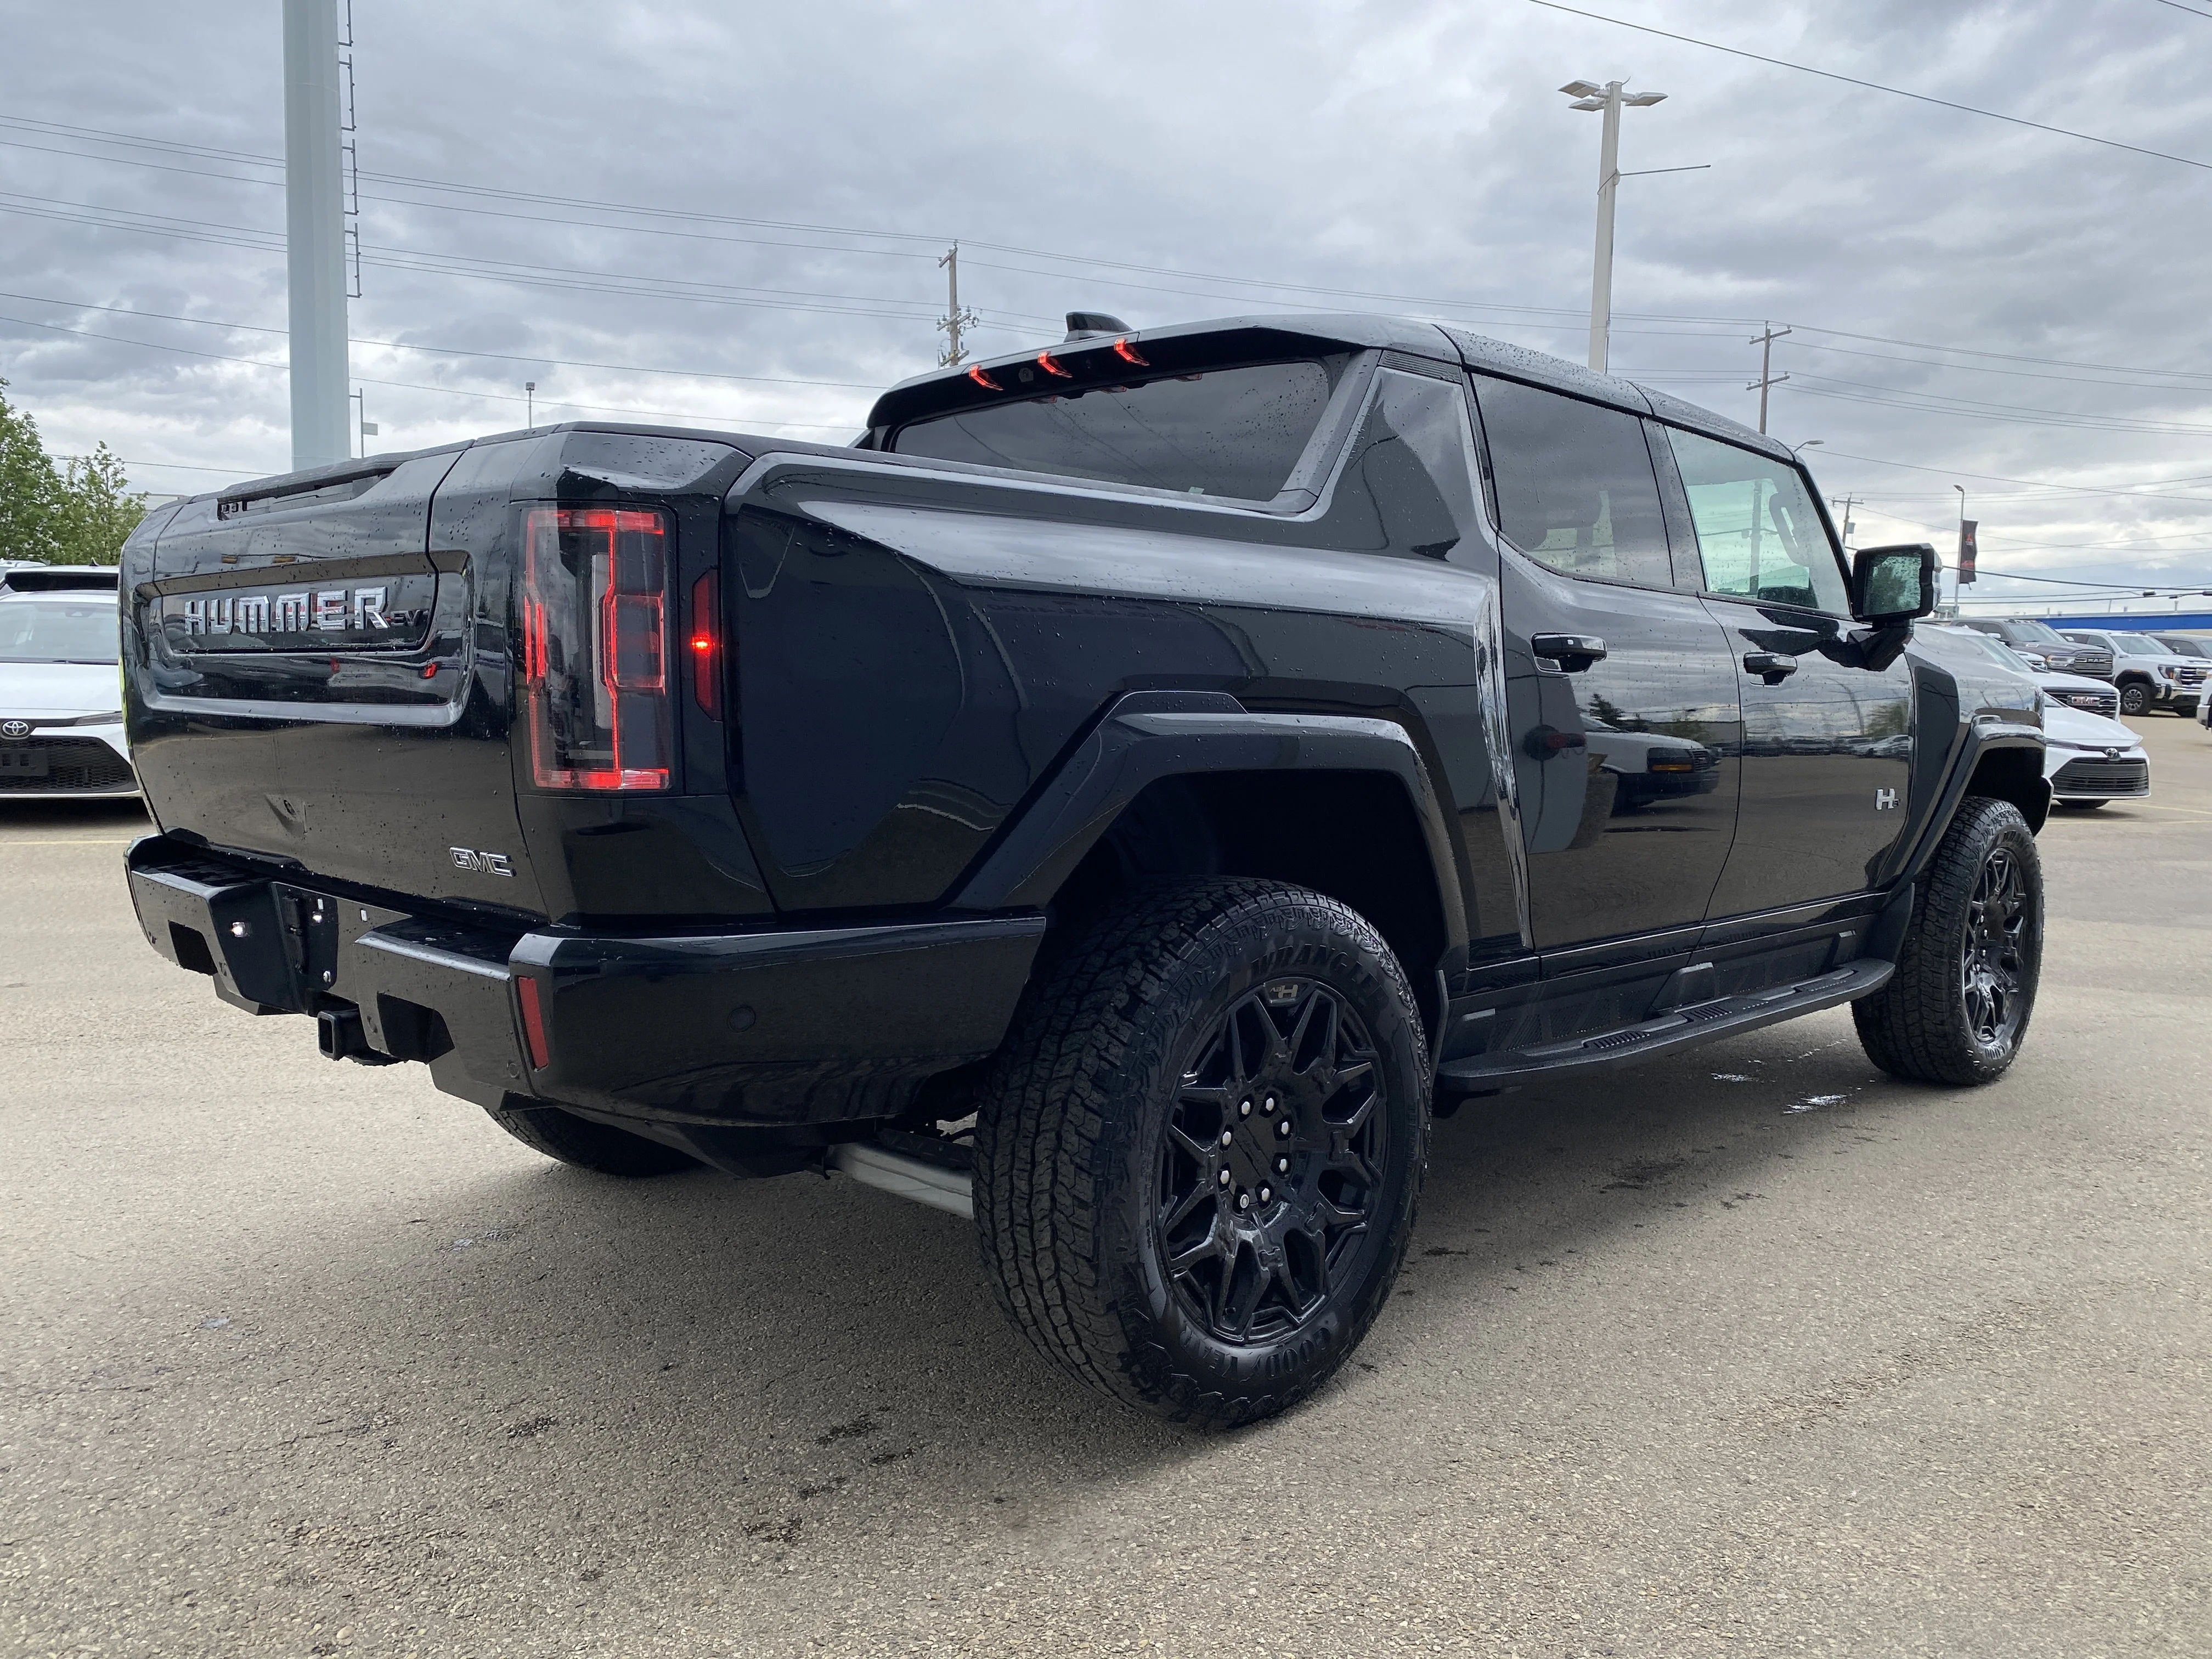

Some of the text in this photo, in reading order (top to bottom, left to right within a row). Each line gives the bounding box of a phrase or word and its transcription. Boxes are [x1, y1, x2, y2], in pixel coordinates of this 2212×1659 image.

[185, 586, 428, 635] HUMMER EV
[2071, 696, 2100, 706] GMC
[449, 846, 517, 877] GMC
